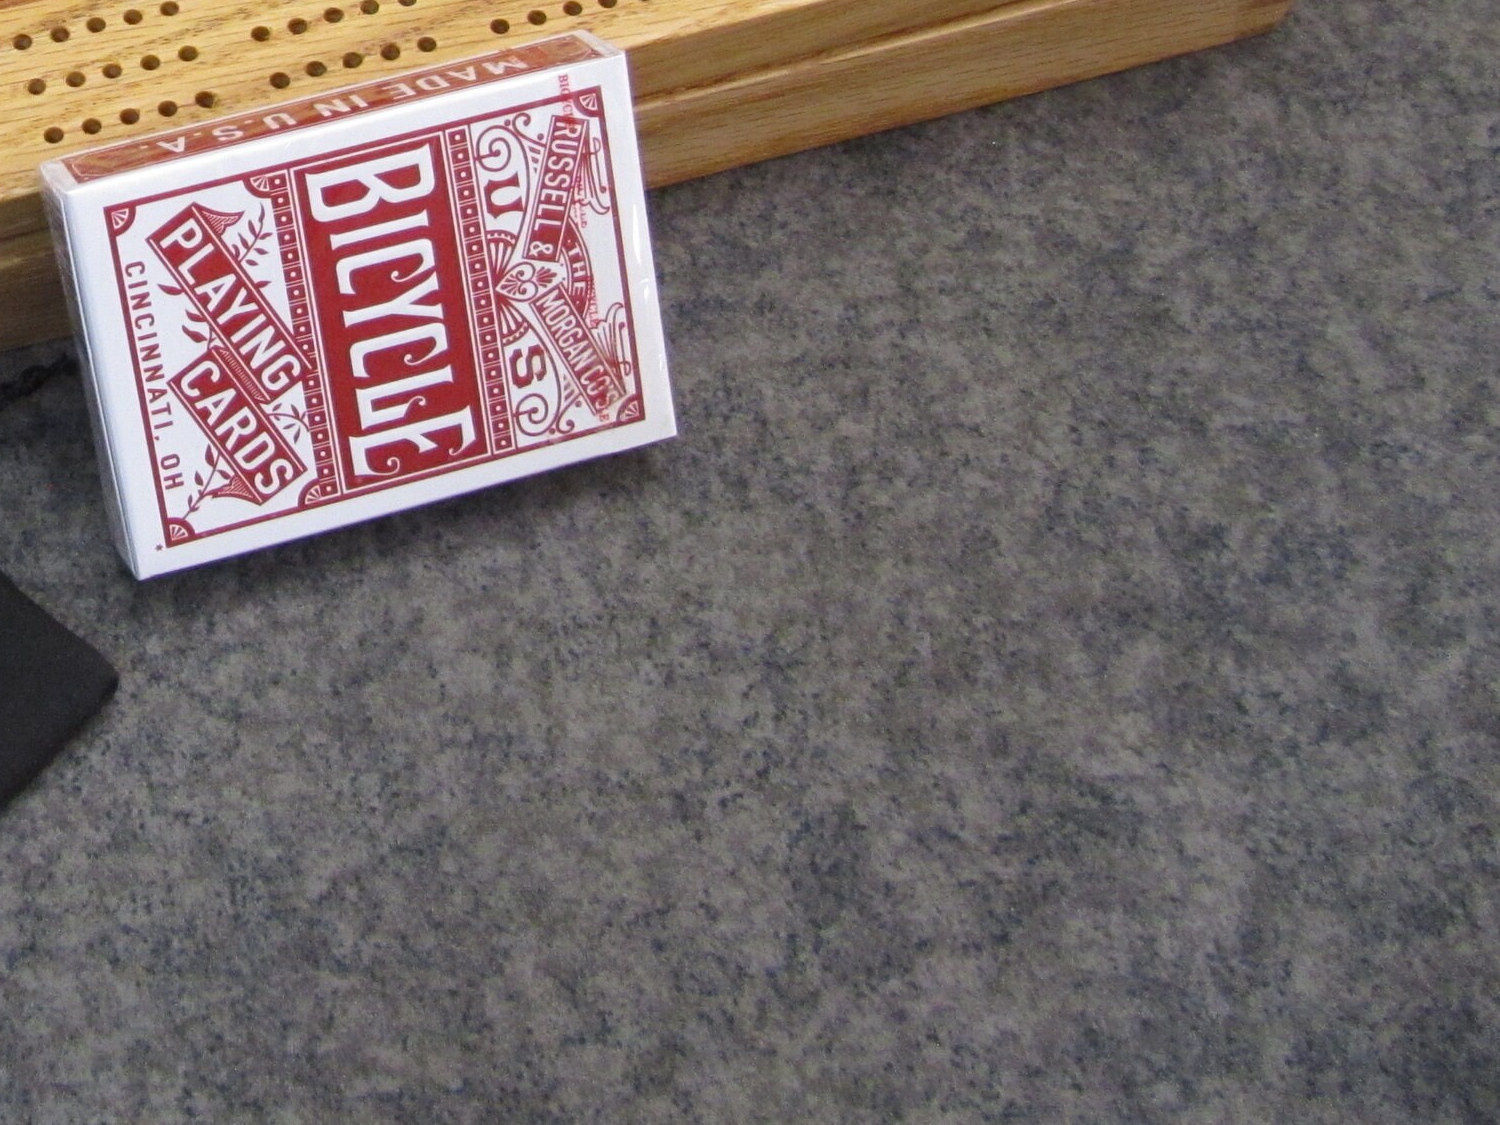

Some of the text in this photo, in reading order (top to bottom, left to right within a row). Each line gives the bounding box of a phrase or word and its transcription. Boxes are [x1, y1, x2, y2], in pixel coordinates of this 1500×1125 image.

[140, 54, 529, 154] MADE IN U.S.A.
[530, 121, 582, 257] RUSSELL &
[159, 217, 301, 391] PLAYING
[305, 142, 477, 476] BICYCLE
[535, 286, 597, 372] MORGAN
[567, 243, 587, 296] THE
[125, 260, 185, 490] CINCINNATI, OH
[180, 360, 294, 495] CARDS
